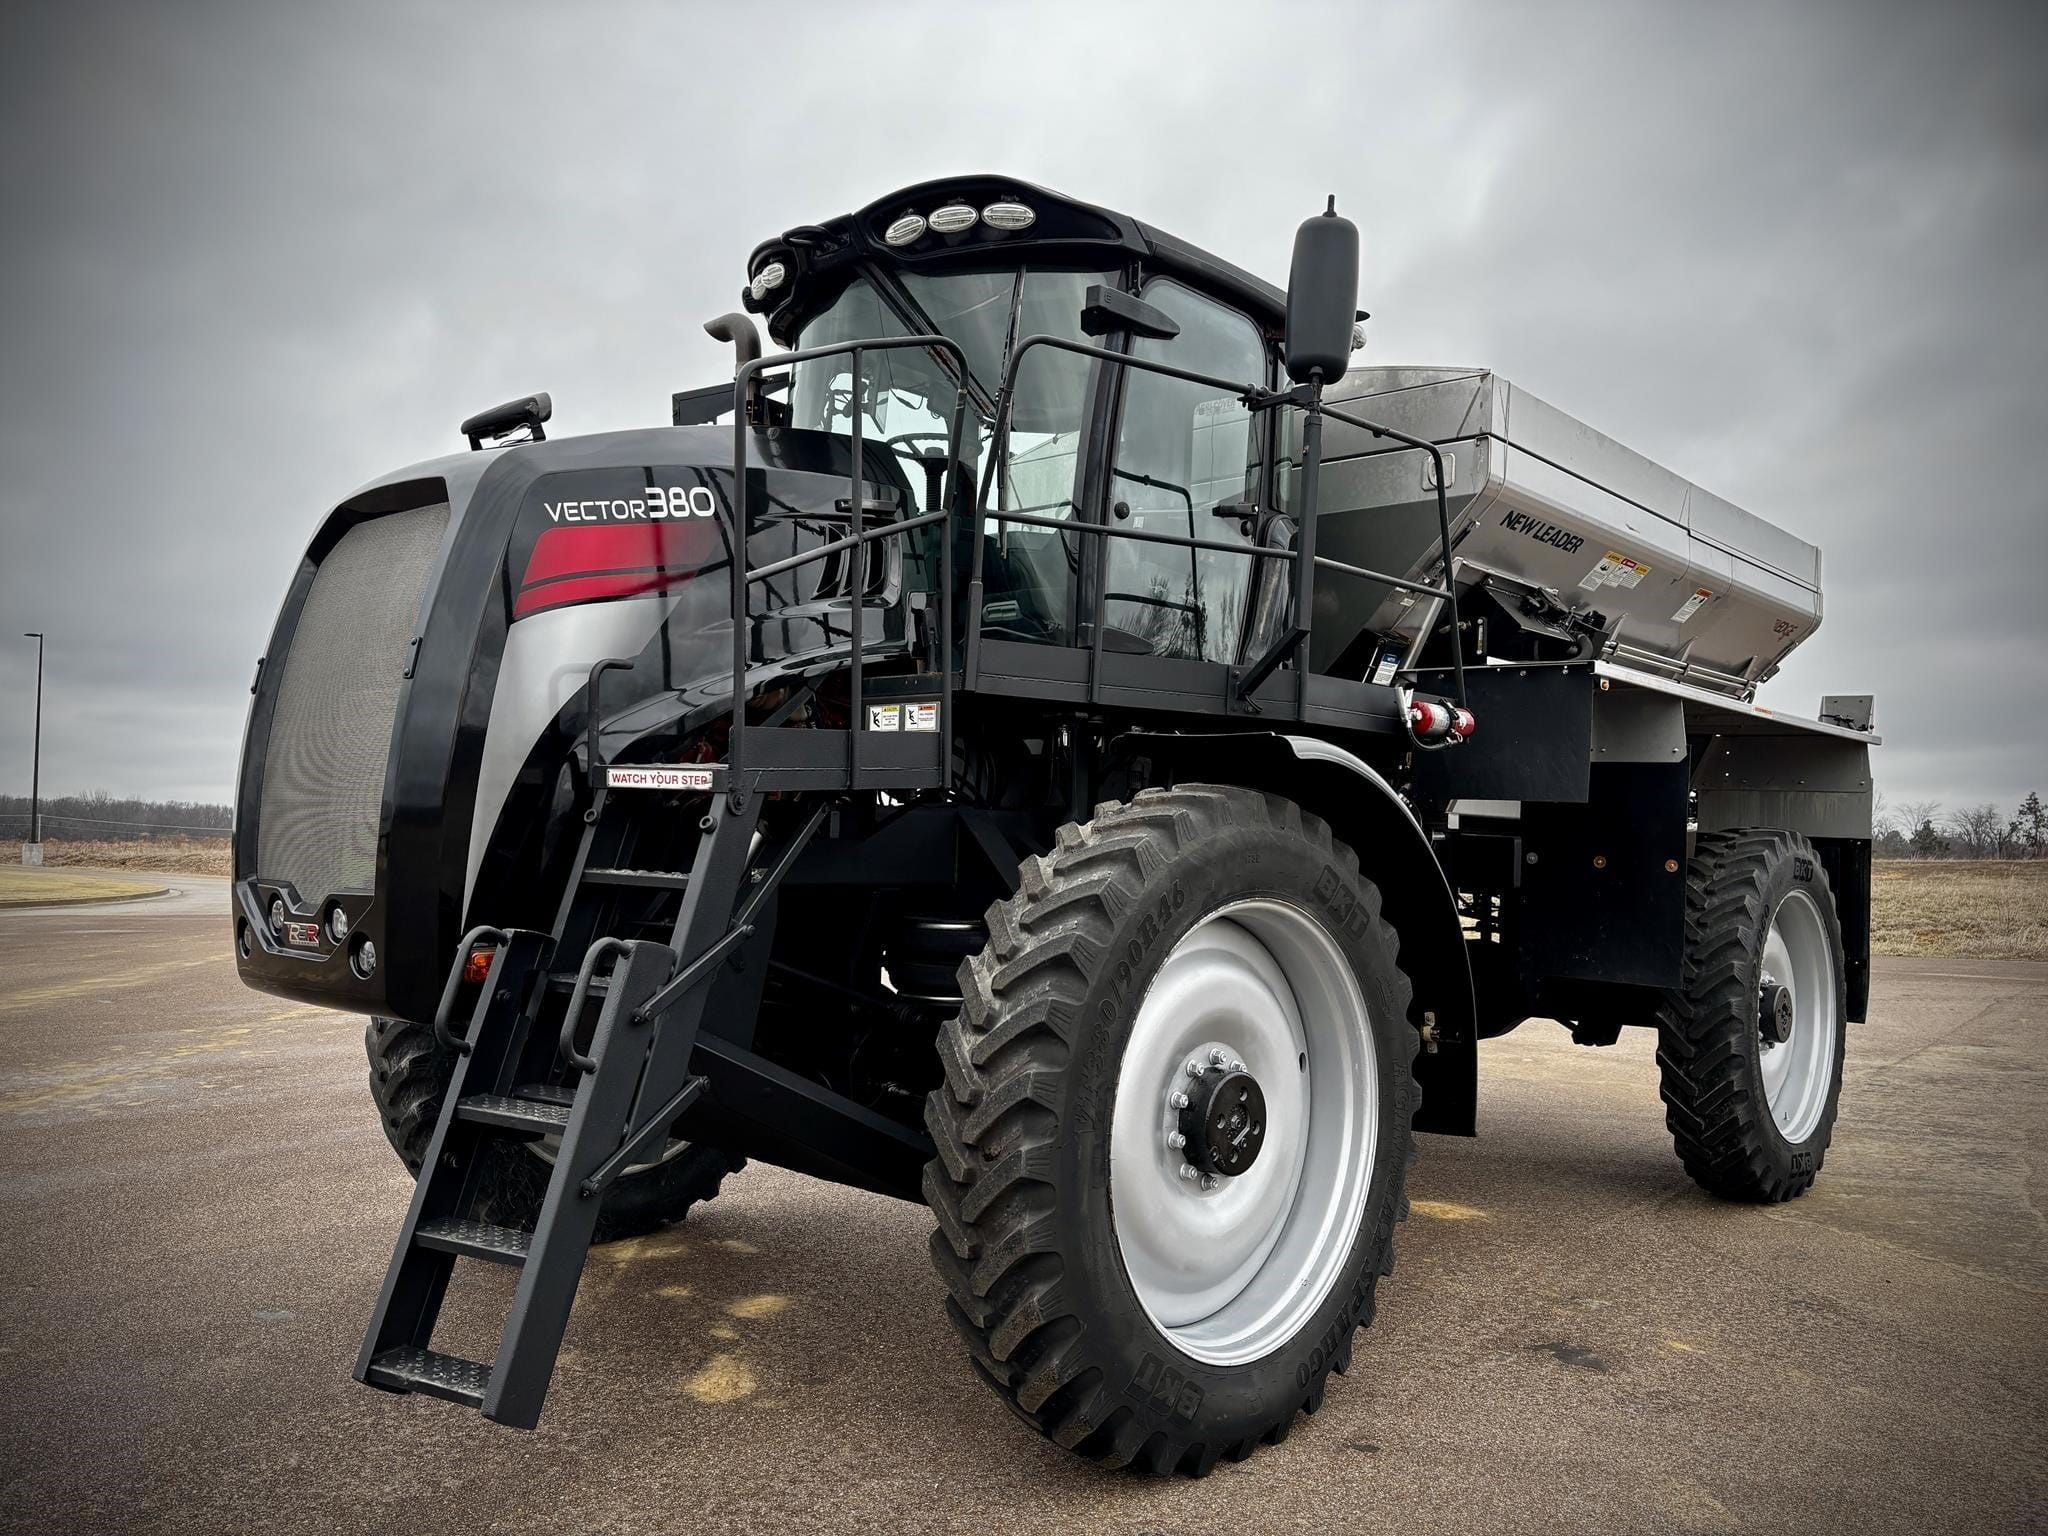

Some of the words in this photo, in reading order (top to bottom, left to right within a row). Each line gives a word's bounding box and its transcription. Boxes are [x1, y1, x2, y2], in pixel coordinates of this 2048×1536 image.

[1500, 510, 1541, 535] NEW
[1533, 522, 1585, 554] LEADER
[611, 773, 647, 784] WATCH
[650, 774, 679, 785] YOUR
[1794, 857, 1813, 882] BKT
